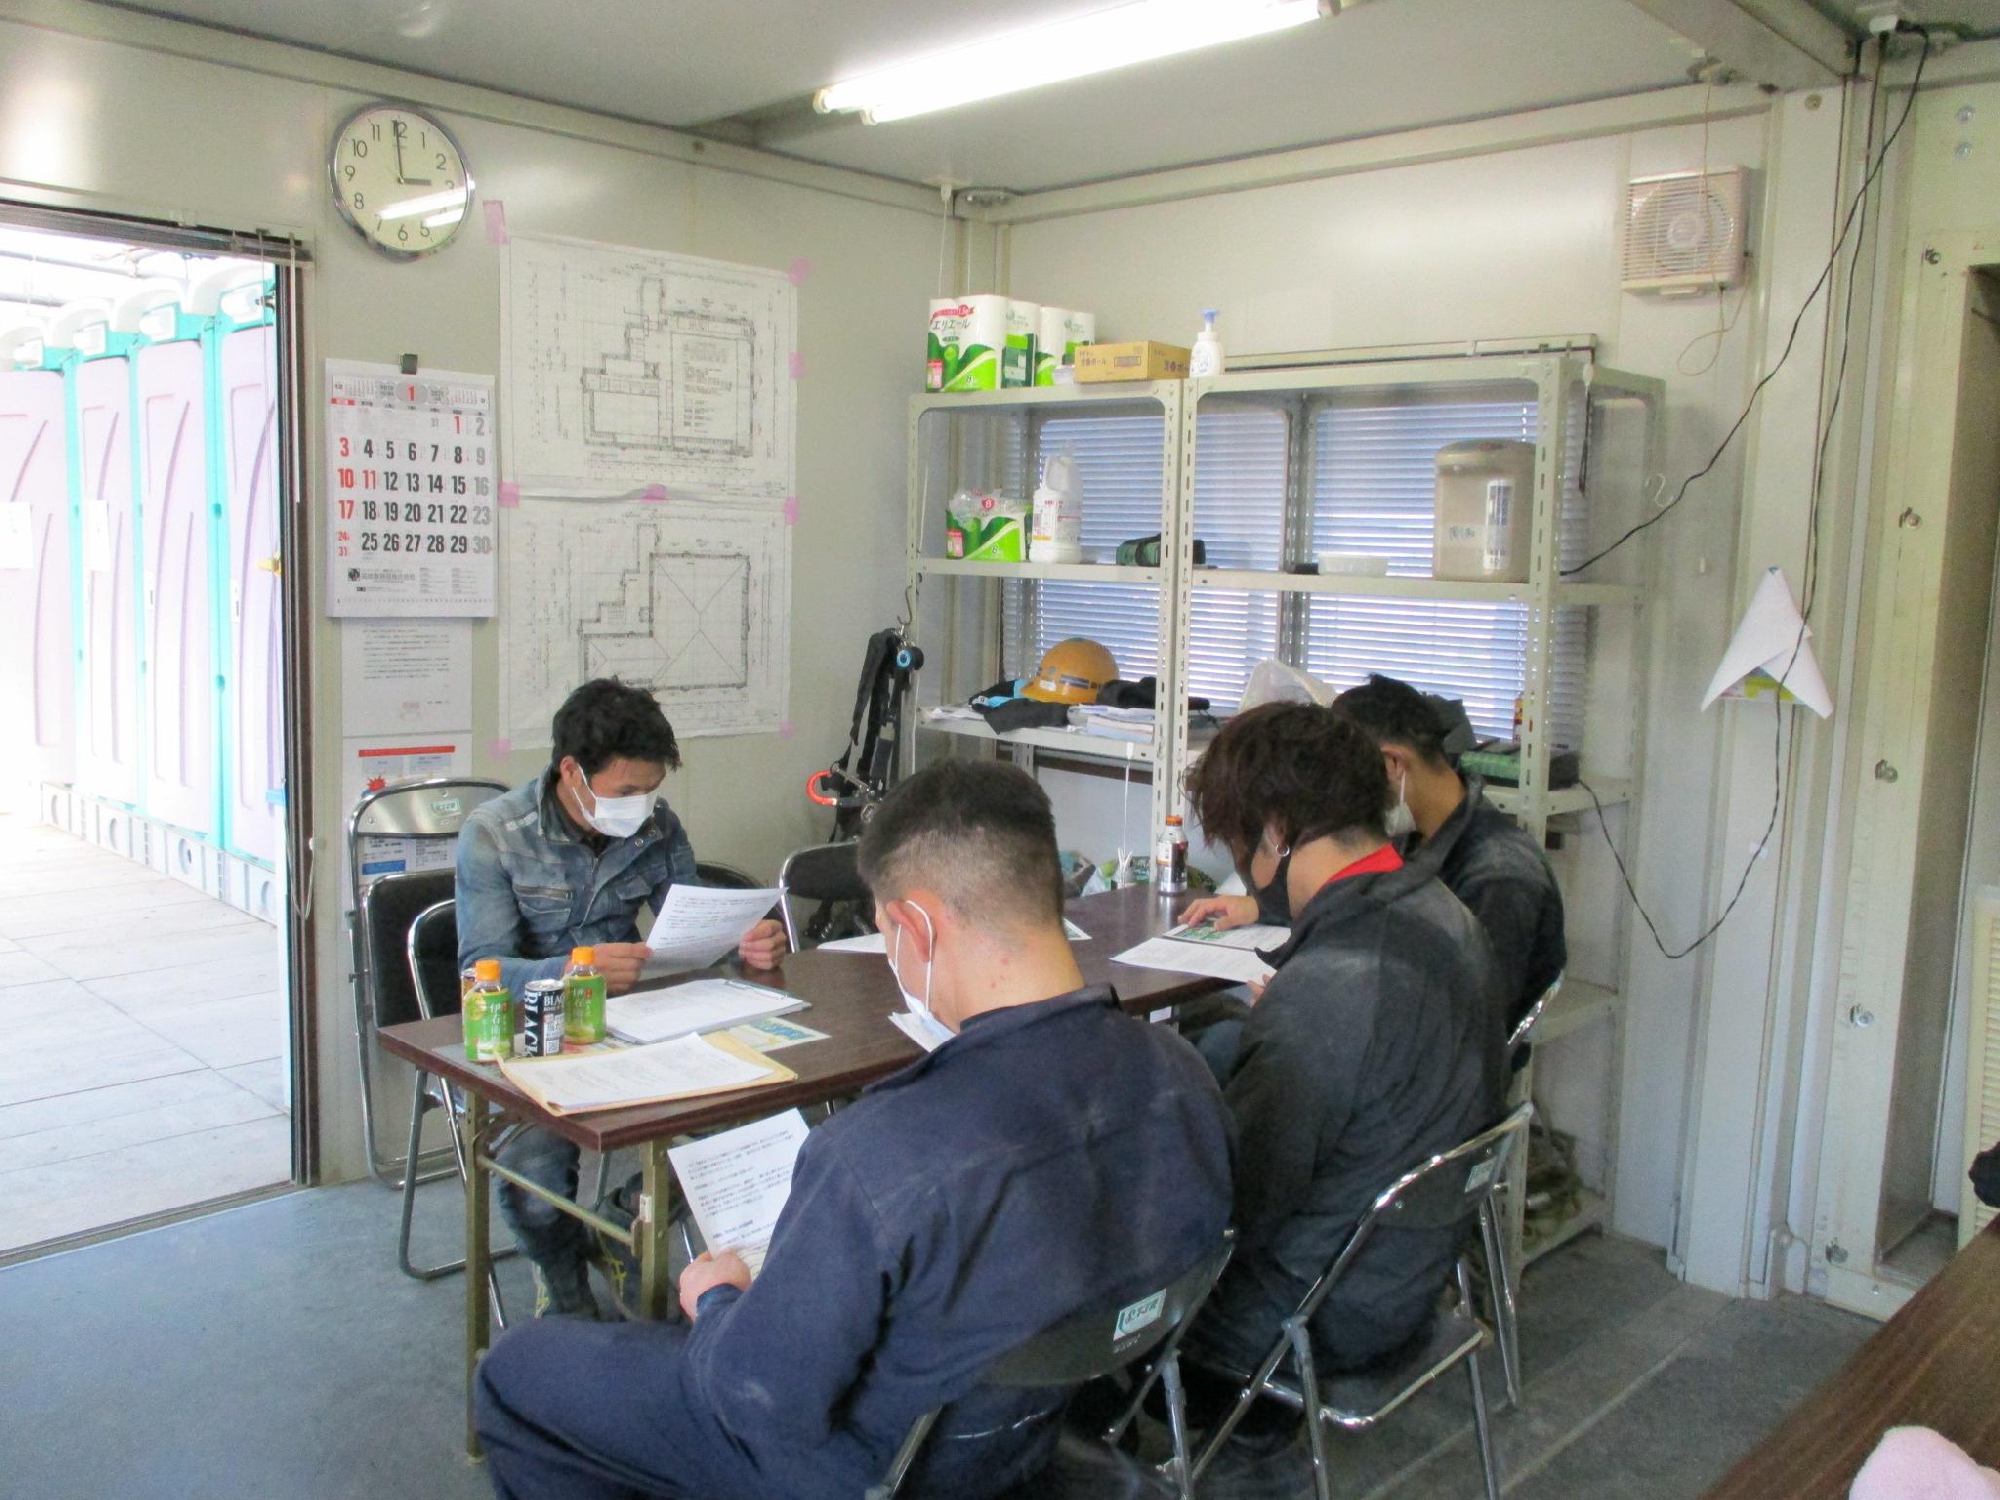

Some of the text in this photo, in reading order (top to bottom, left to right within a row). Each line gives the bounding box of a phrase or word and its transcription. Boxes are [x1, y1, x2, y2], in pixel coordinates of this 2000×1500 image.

[371, 124, 380, 142] 11
[391, 120, 407, 138] 12
[352, 139, 367, 157] 10
[421, 132, 425, 149] 1
[436, 154, 446, 170] 2
[345, 166, 355, 181] 9
[354, 193, 364, 210] 8
[398, 225, 408, 241] 6
[933, 319, 970, 332] エリエール
[407, 386, 415, 402] 1
[454, 416, 460, 434] 1
[476, 417, 484, 436] 2
[339, 437, 486, 465] 3 4 5 6 7 8 9
[338, 468, 489, 496] 10 11 12 13 14 15 16
[339, 500, 490, 525] 17 18 19 20 21 22 23
[338, 531, 491, 554] 24 25 26 27 28 29 30
[338, 547, 348, 556] 31
